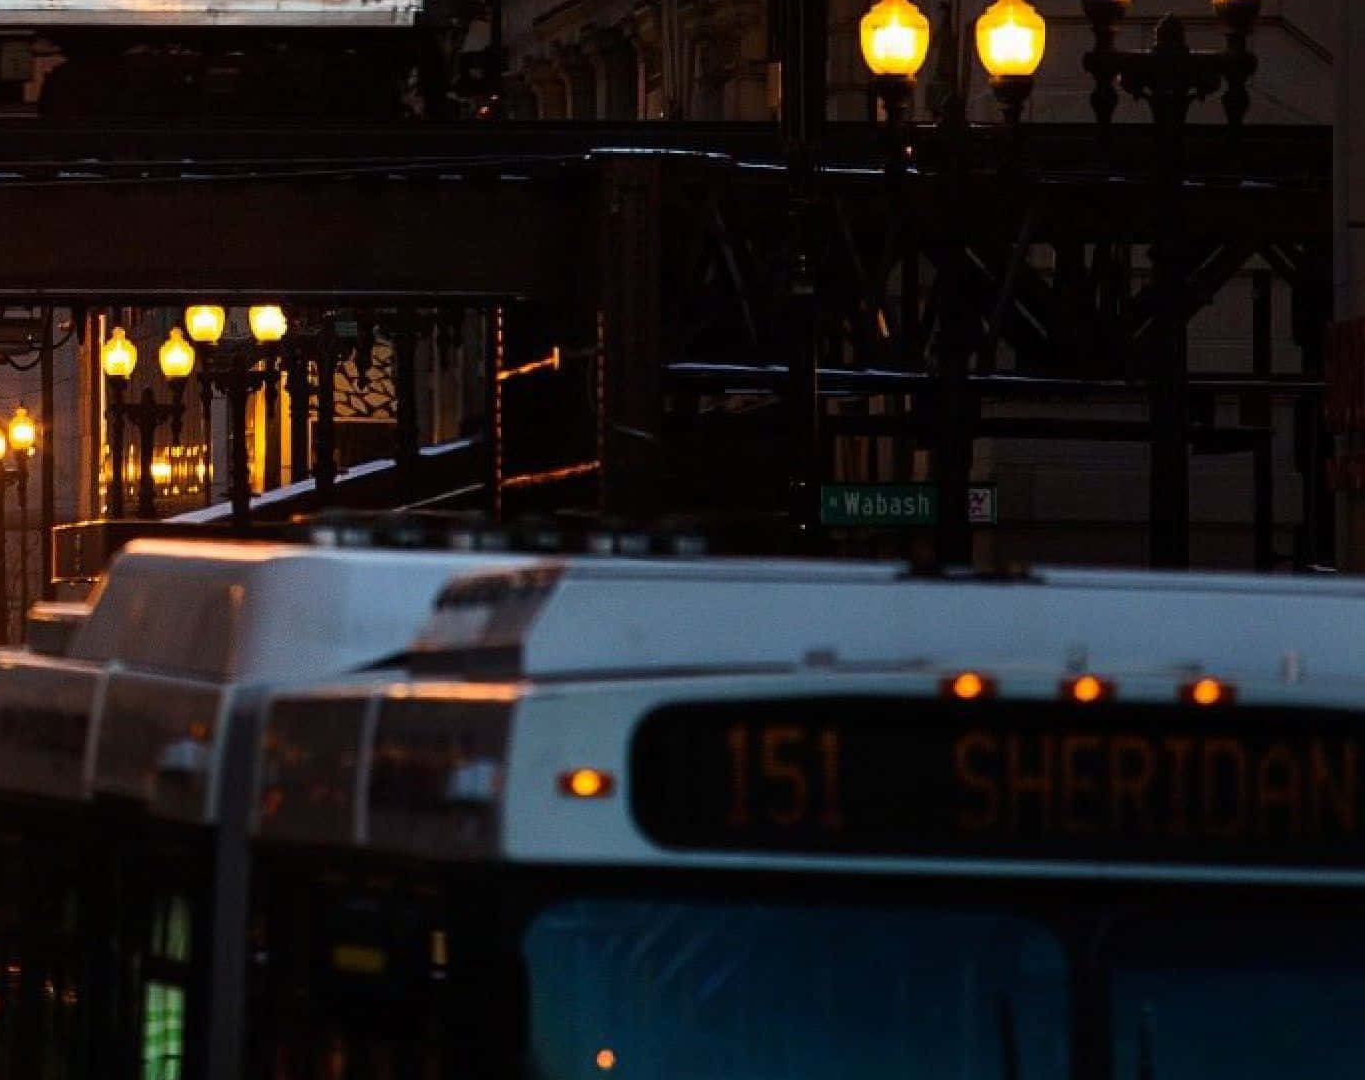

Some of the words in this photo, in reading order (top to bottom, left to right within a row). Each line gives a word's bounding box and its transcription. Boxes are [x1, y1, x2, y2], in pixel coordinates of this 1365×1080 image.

[843, 491, 930, 517] Wabash
[723, 722, 846, 829] 151
[949, 728, 1361, 840] SHERIDAN
